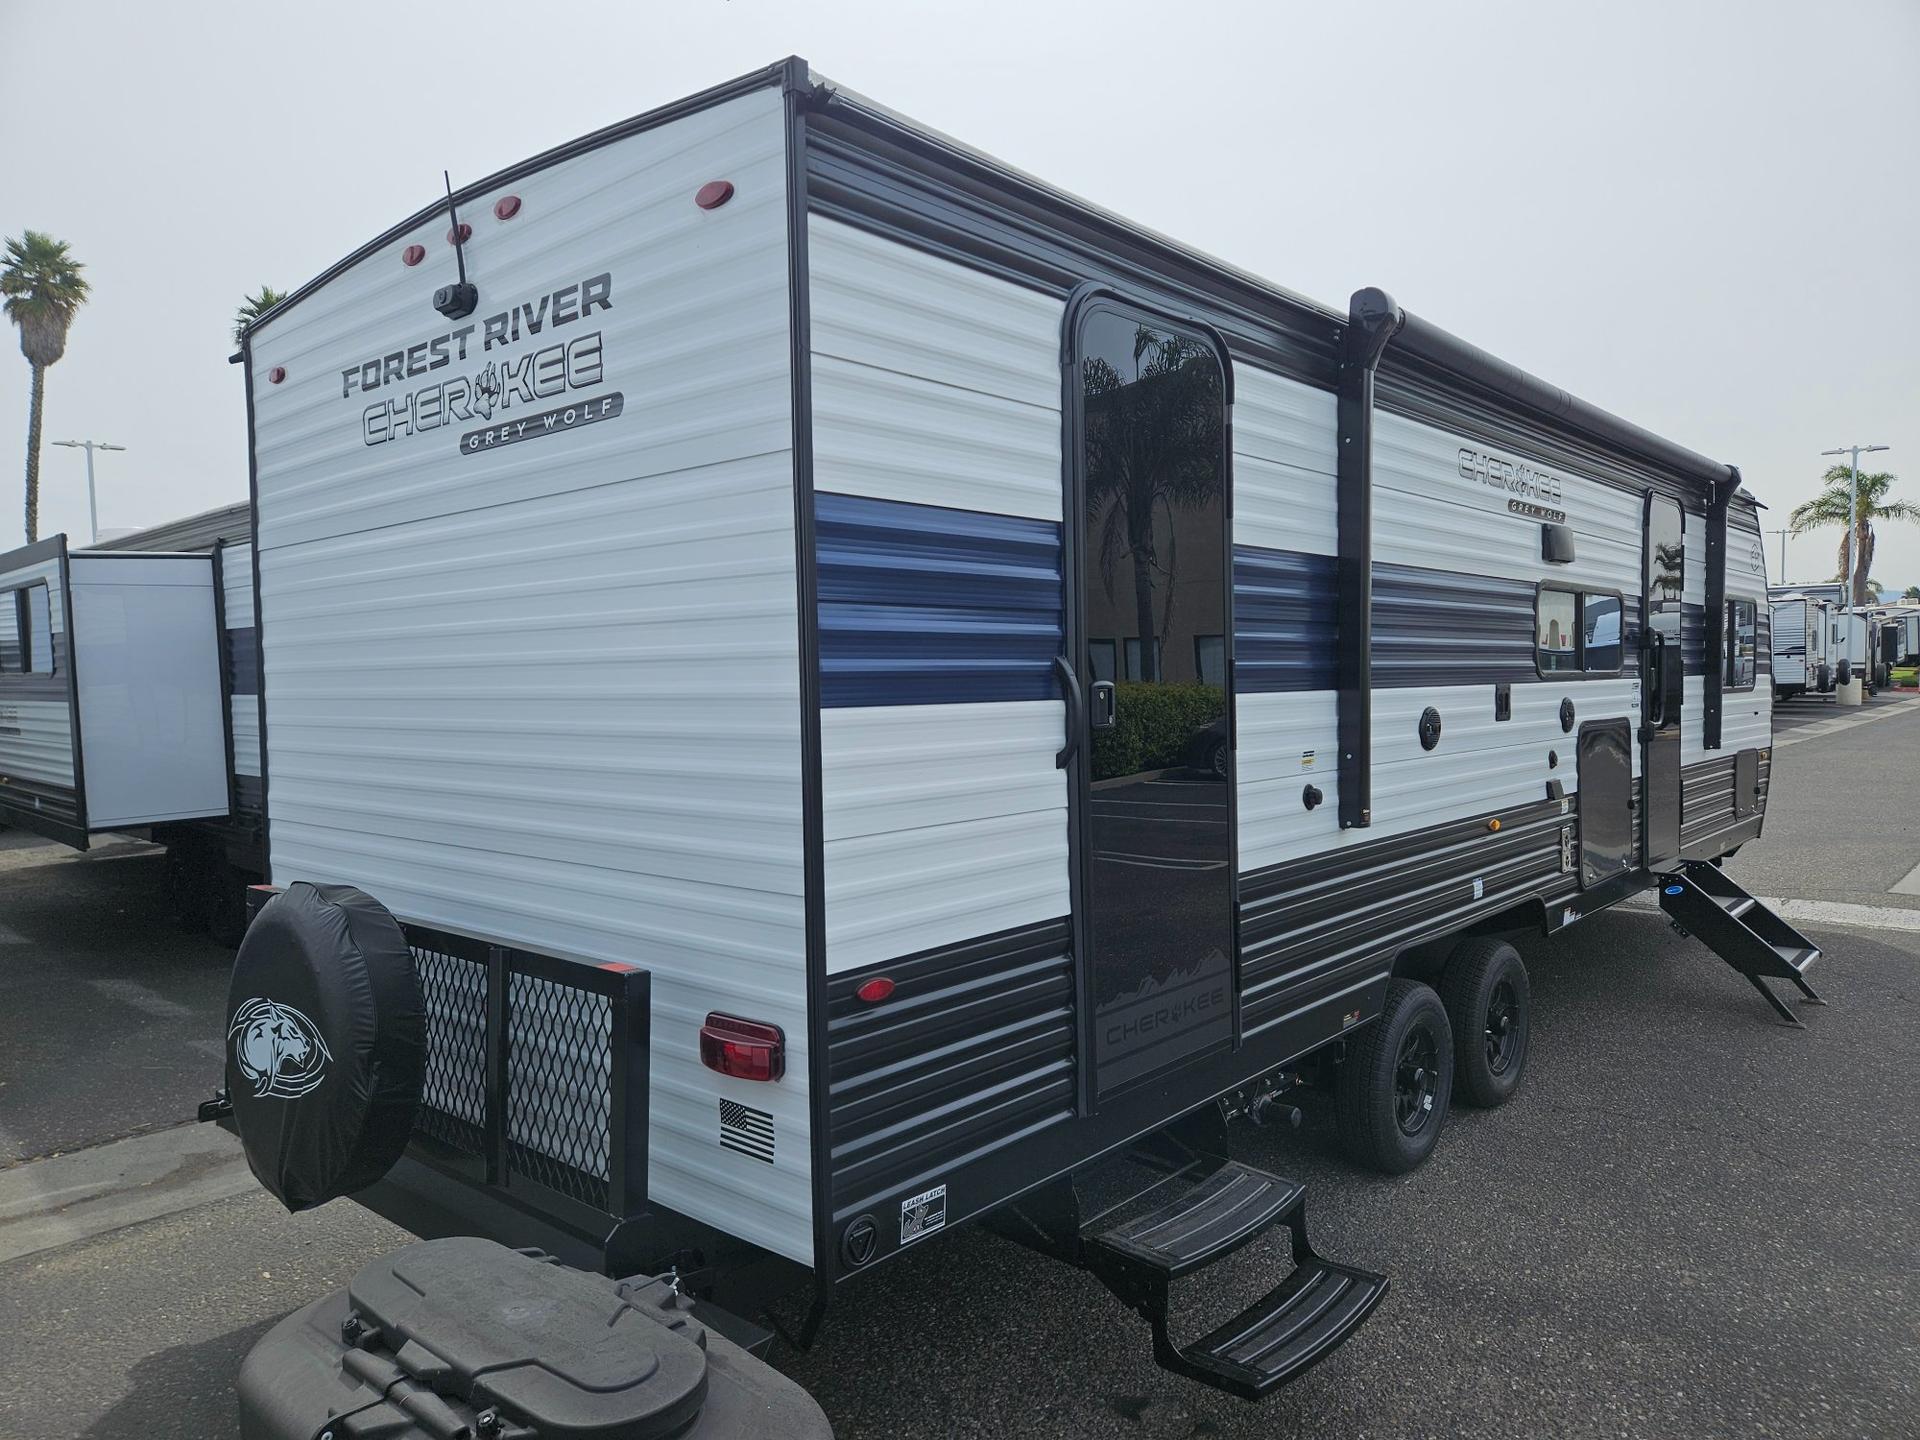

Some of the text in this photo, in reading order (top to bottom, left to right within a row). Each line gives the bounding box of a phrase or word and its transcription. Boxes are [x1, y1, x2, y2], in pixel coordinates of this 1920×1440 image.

[341, 272, 613, 398] FOREST RIVER
[469, 397, 612, 449] GREY WOLF
[1511, 501, 1536, 515] GREY
[903, 1187, 946, 1209] LEASH LATCH
